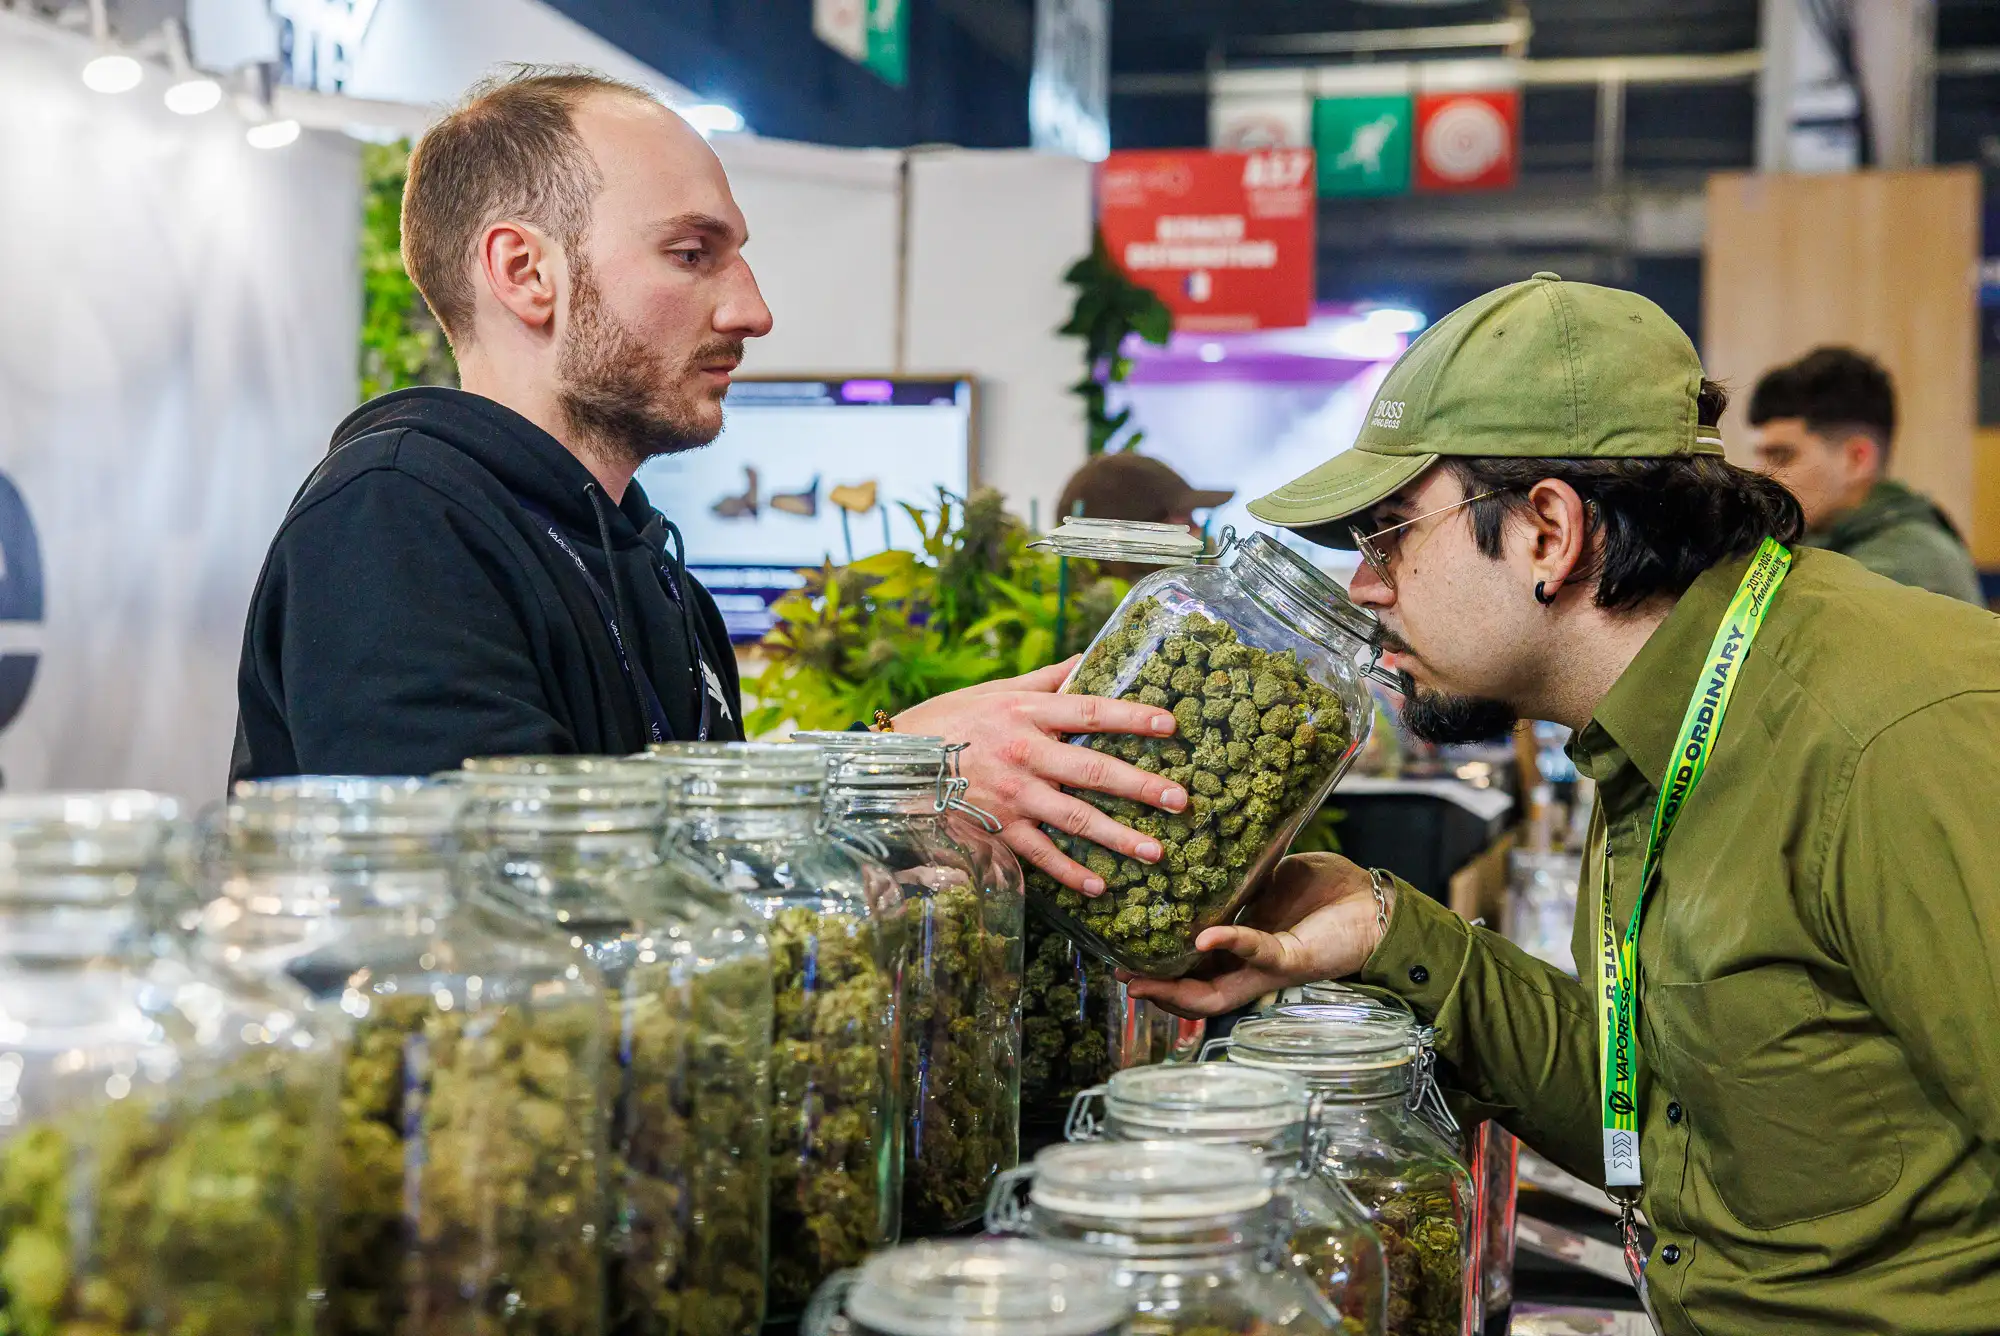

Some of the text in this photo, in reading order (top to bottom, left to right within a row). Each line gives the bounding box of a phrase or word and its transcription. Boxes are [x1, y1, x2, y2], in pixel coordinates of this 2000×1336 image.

[1374, 400, 1406, 419] BOSS
[1383, 418, 1401, 429] BOSS
[1746, 551, 1773, 592] 2015-2025
[1749, 556, 1786, 617] Anniversary
[1684, 623, 1746, 762] ORDINARY
[1615, 976, 1631, 1082] VAPORESSO
